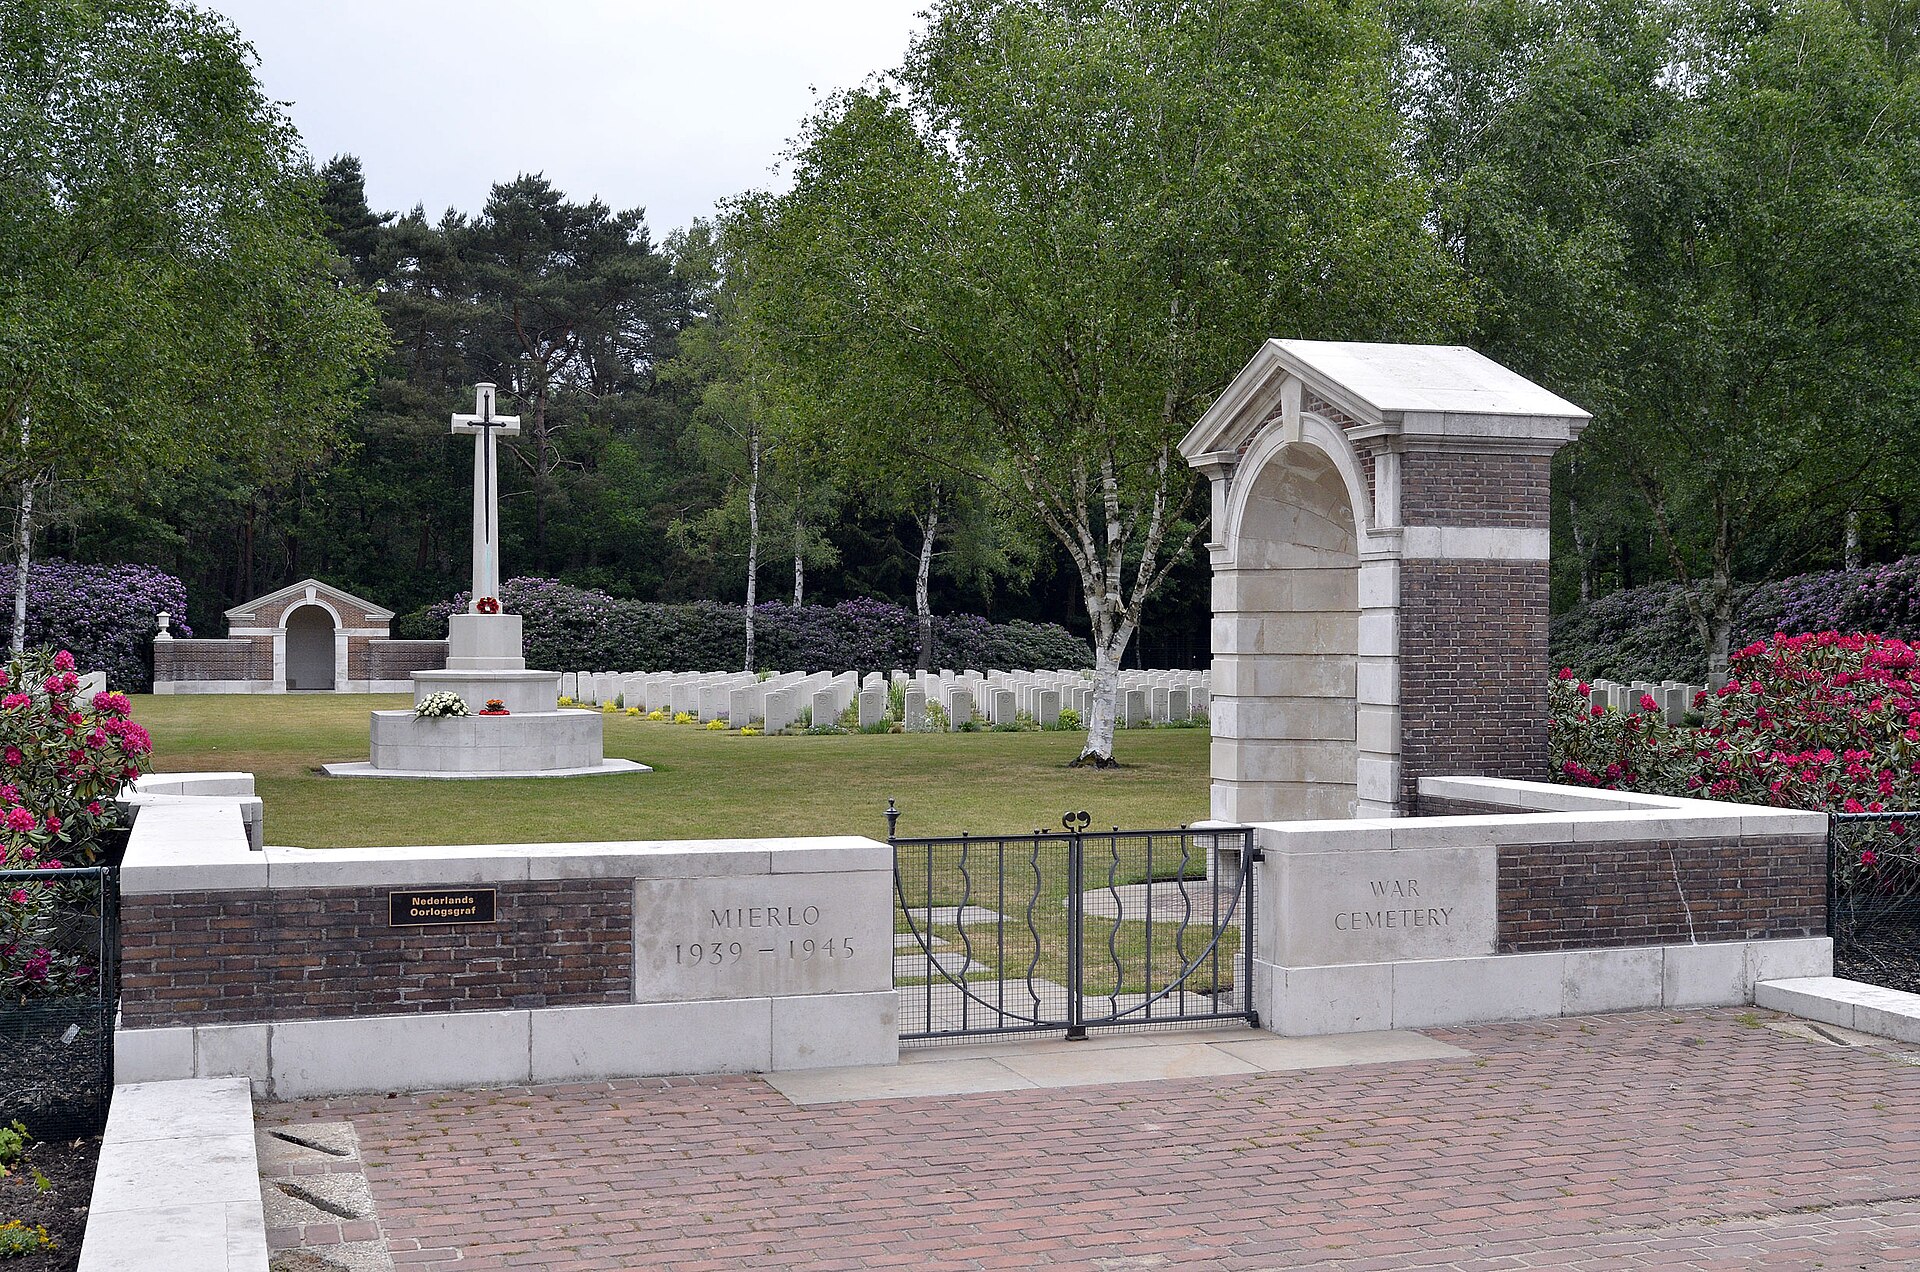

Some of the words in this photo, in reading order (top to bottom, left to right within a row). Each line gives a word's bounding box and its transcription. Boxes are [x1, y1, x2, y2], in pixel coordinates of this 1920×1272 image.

[1370, 879, 1420, 898] WAR
[410, 906, 477, 917] Oorlogsgraf
[412, 896, 474, 906] Nederlands
[711, 905, 820, 929] MIERLO
[1334, 907, 1453, 931] CEMETERY
[675, 942, 743, 968] 1939
[788, 937, 854, 962] 1945
